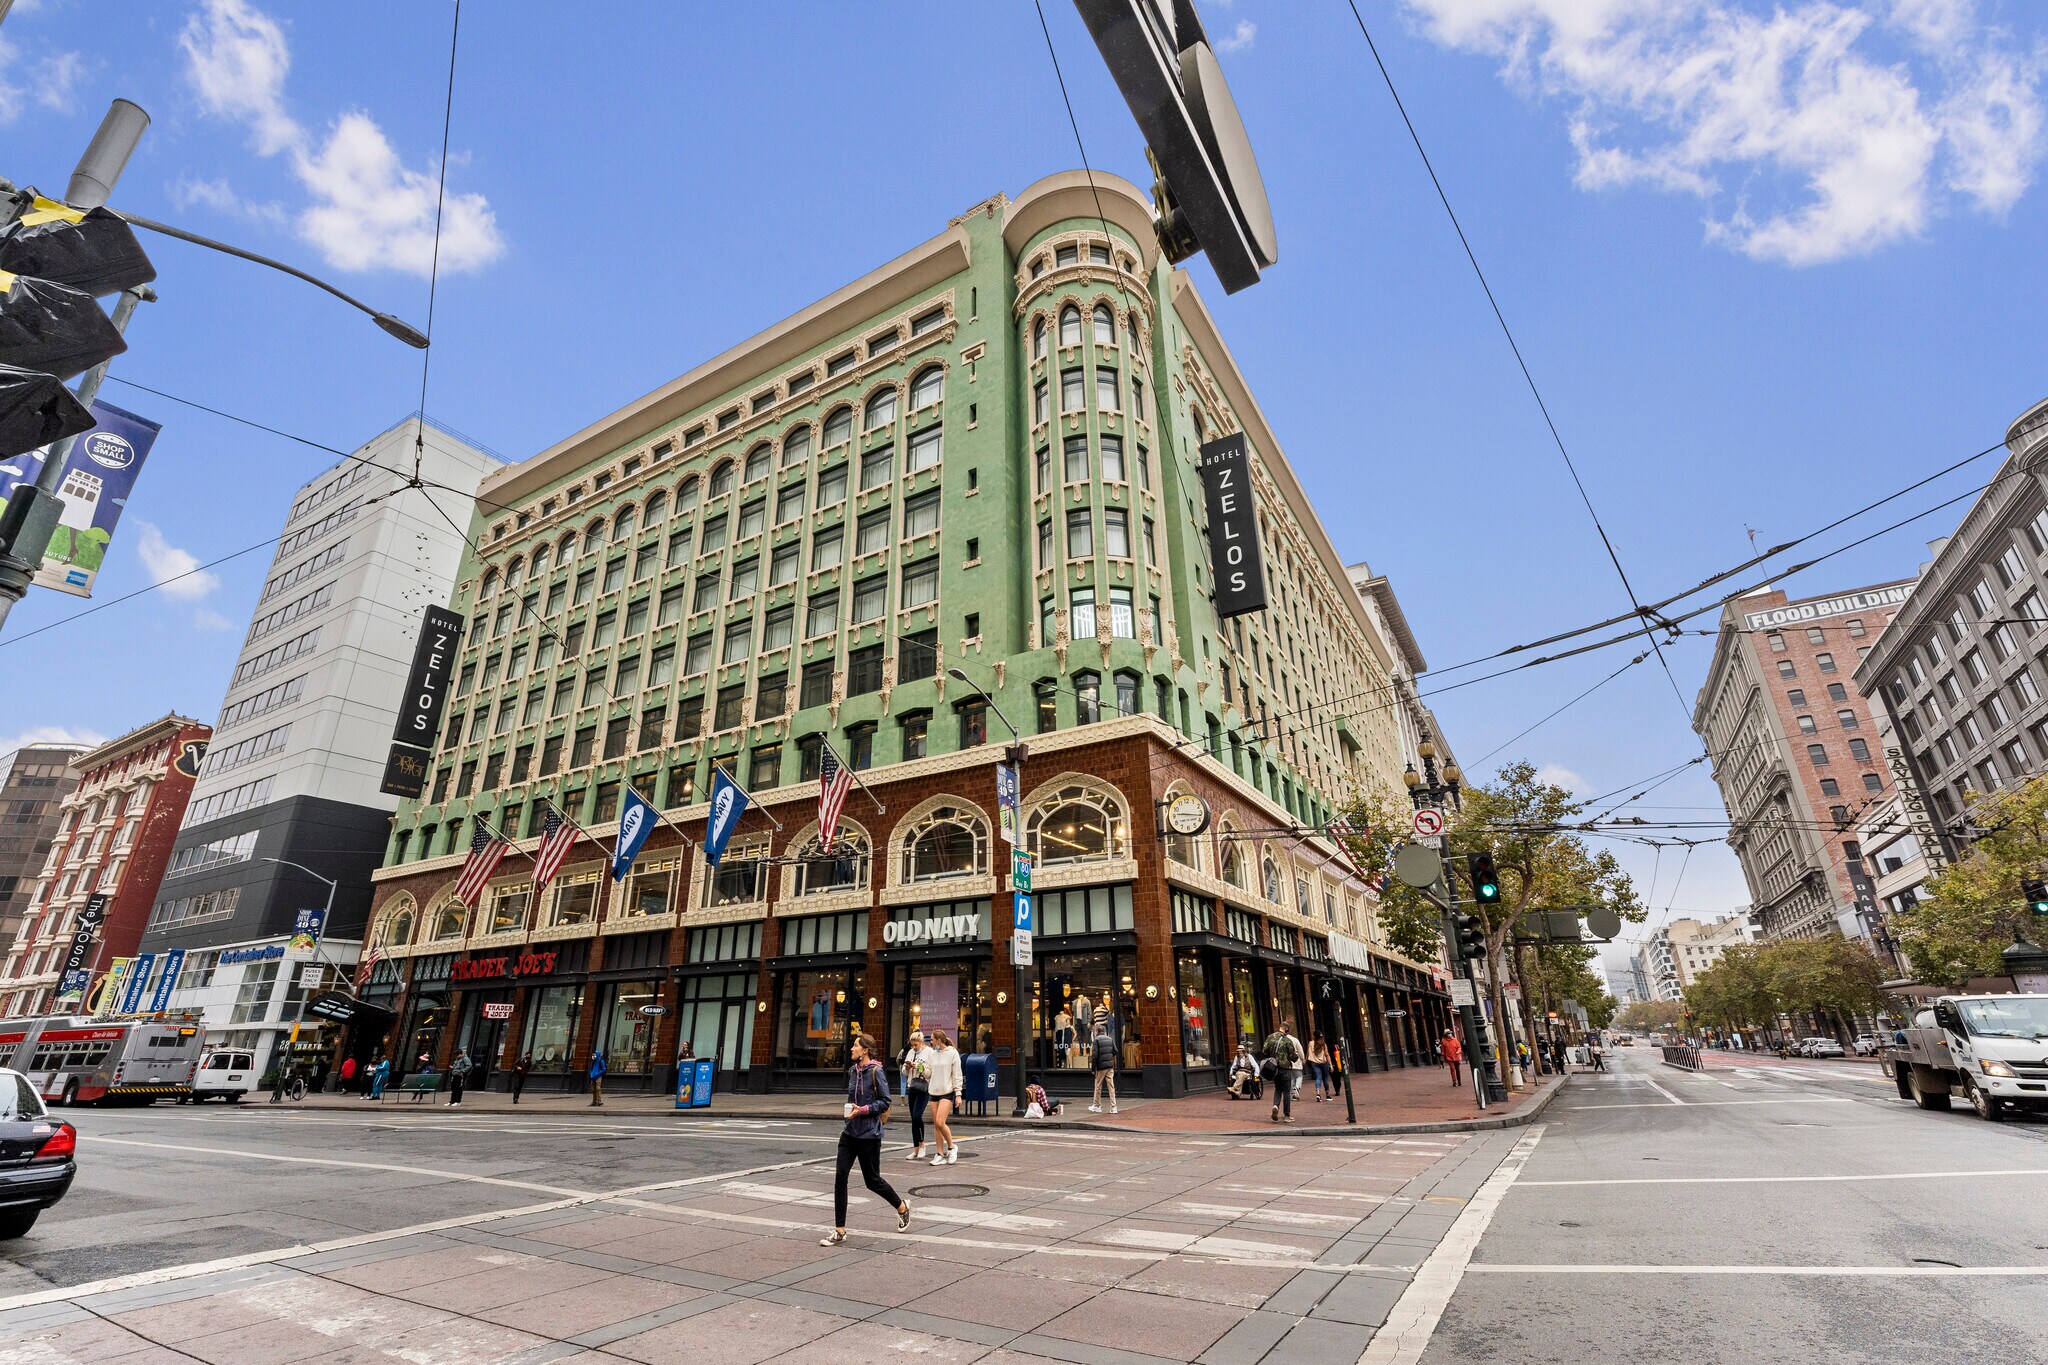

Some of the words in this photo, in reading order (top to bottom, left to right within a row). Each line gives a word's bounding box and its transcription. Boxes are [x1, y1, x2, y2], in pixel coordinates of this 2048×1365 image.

[93, 447, 126, 462] SMALL
[96, 440, 125, 454] SHOP
[1206, 449, 1241, 466] HOTEL
[1218, 468, 1247, 592] ZELOS
[431, 617, 458, 632] HOTEL
[1751, 605, 1815, 629] FLOOD
[413, 633, 447, 730] ZELOS
[1887, 748, 1923, 811] SAVING
[714, 792, 730, 822] NAVY
[622, 810, 641, 840] NAVY
[1021, 862, 1029, 873] 80
[86, 899, 104, 918] The
[883, 920, 923, 943] OLD
[924, 914, 981, 940] NAVY
[231, 947, 264, 962] Container
[264, 945, 285, 959] Store
[451, 957, 509, 980] TRADER
[513, 952, 557, 976] JOE'S
[124, 979, 143, 1013] Container
[137, 960, 150, 979] Store
[153, 975, 172, 1011] Container
[166, 956, 180, 975] Store
